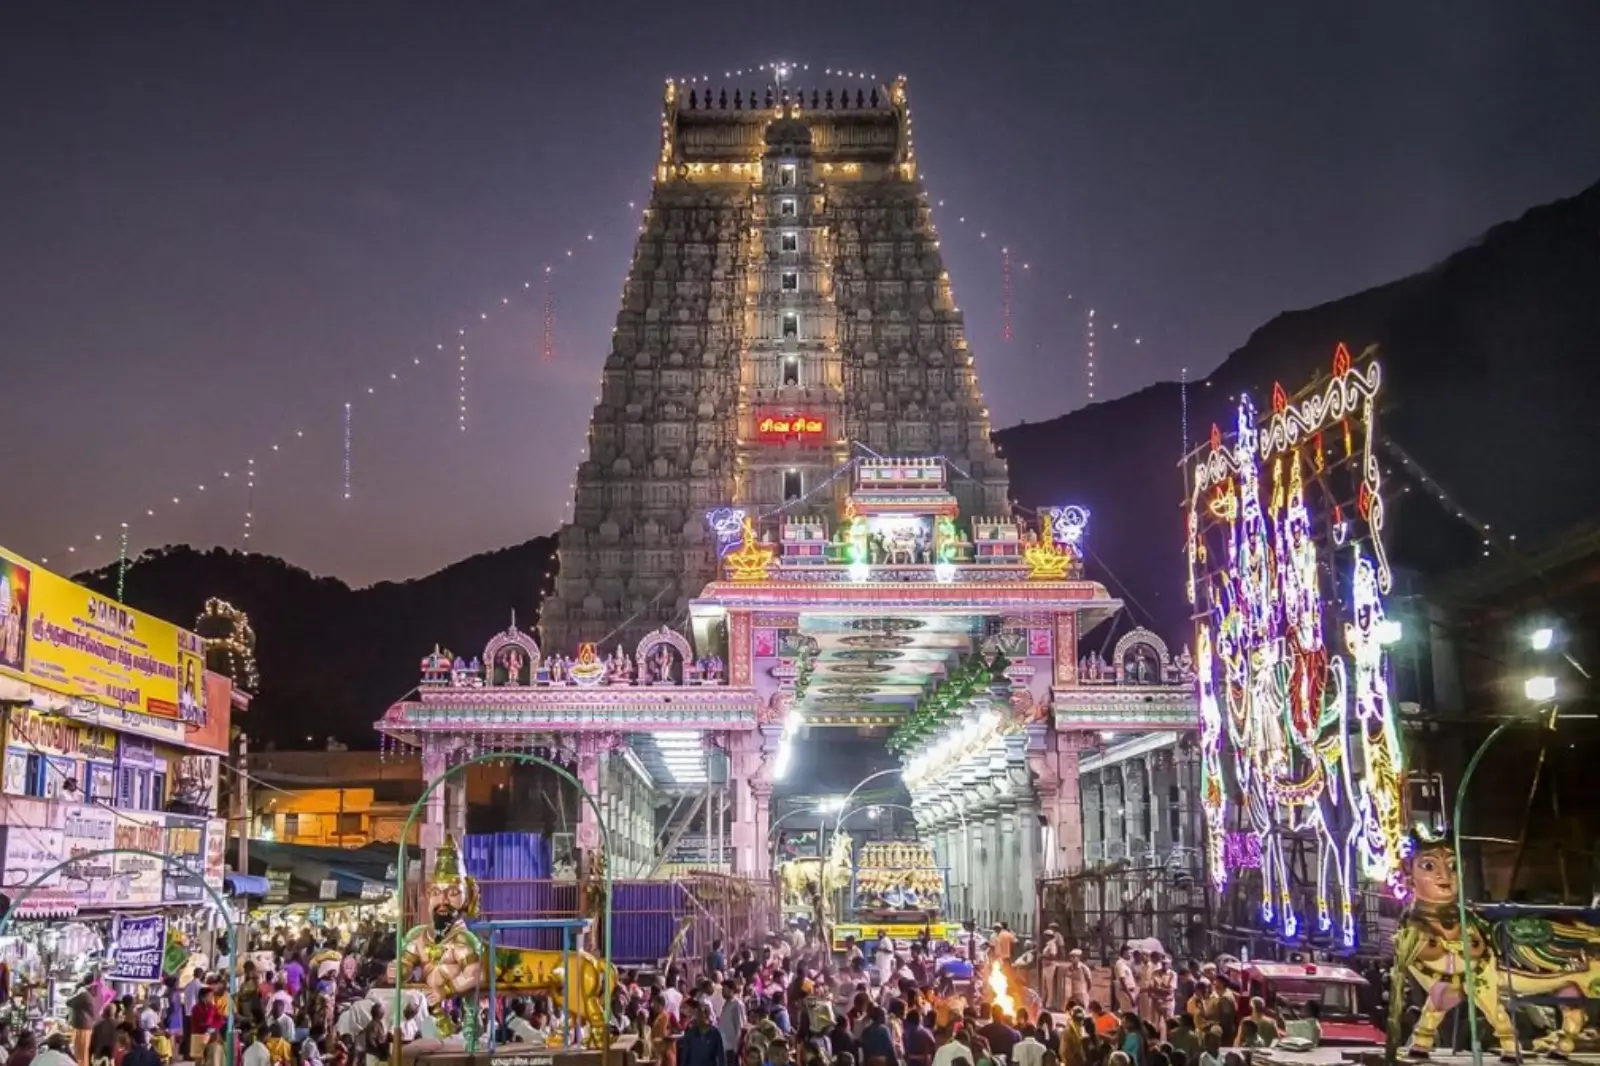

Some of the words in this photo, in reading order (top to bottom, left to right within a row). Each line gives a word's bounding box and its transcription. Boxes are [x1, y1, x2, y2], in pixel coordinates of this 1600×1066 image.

[760, 418, 789, 432] சிவ
[792, 417, 822, 432] சிவ
[116, 951, 159, 965] LUGGAGE
[117, 963, 153, 976] CENTER
